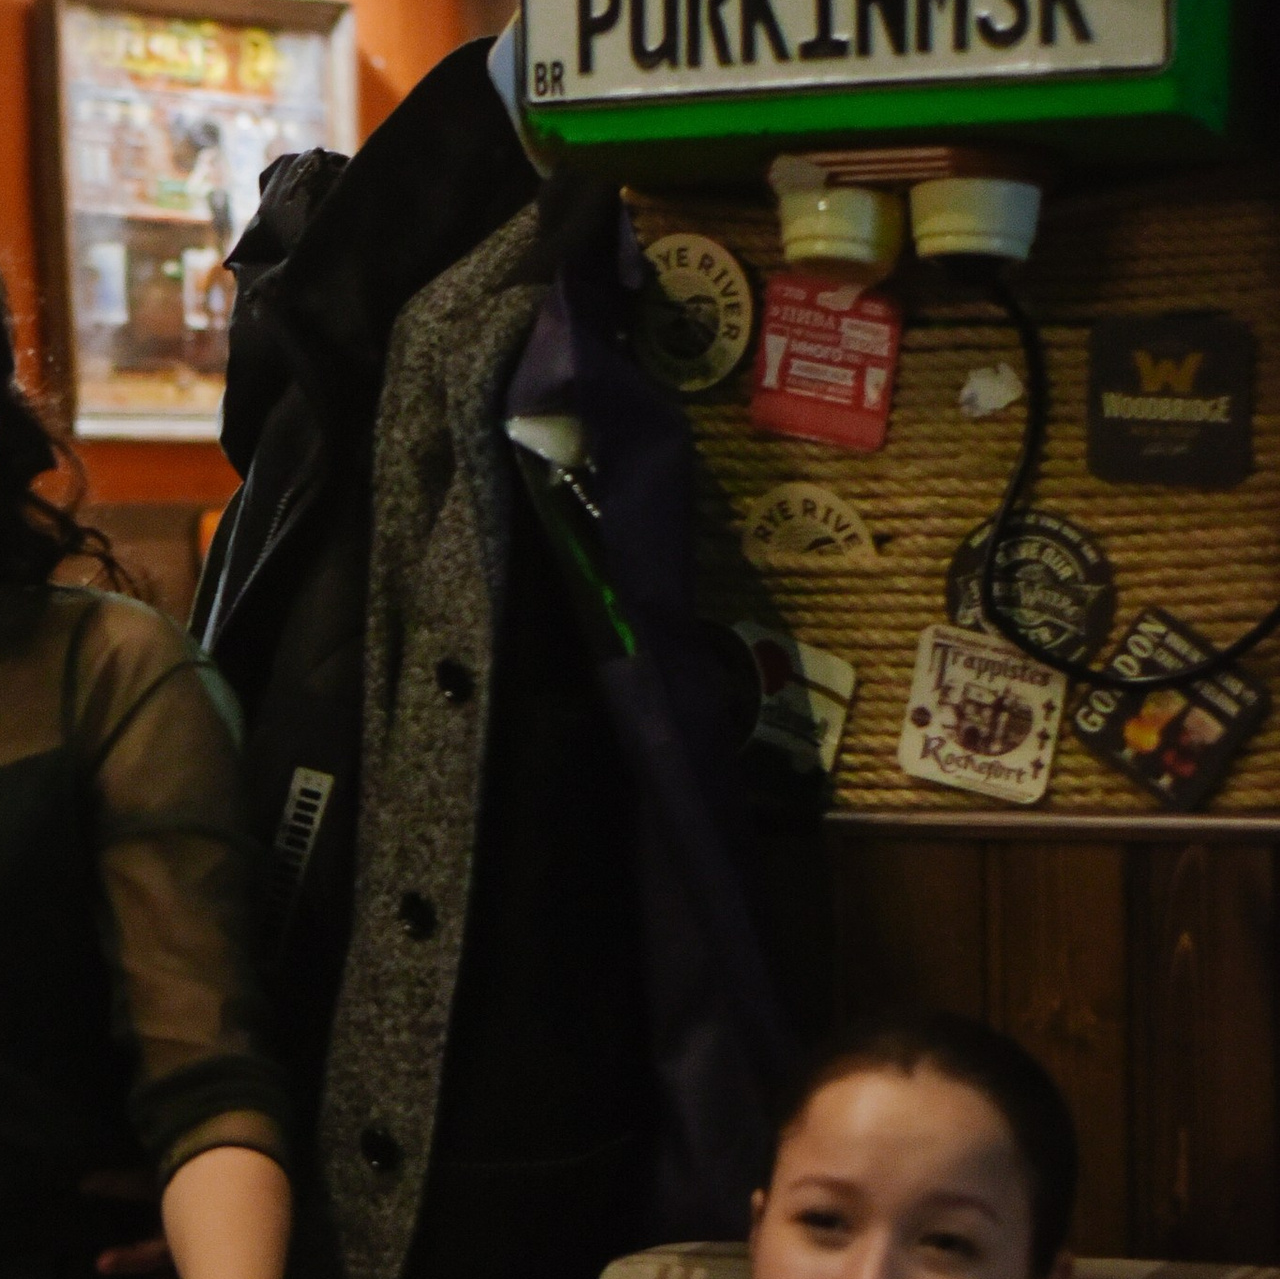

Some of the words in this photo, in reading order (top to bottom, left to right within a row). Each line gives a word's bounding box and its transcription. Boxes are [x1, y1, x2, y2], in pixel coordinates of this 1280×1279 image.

[534, 60, 566, 98] BR
[697, 252, 742, 341] RIVER
[753, 499, 795, 544] RYE
[1074, 612, 1169, 734] GODON
